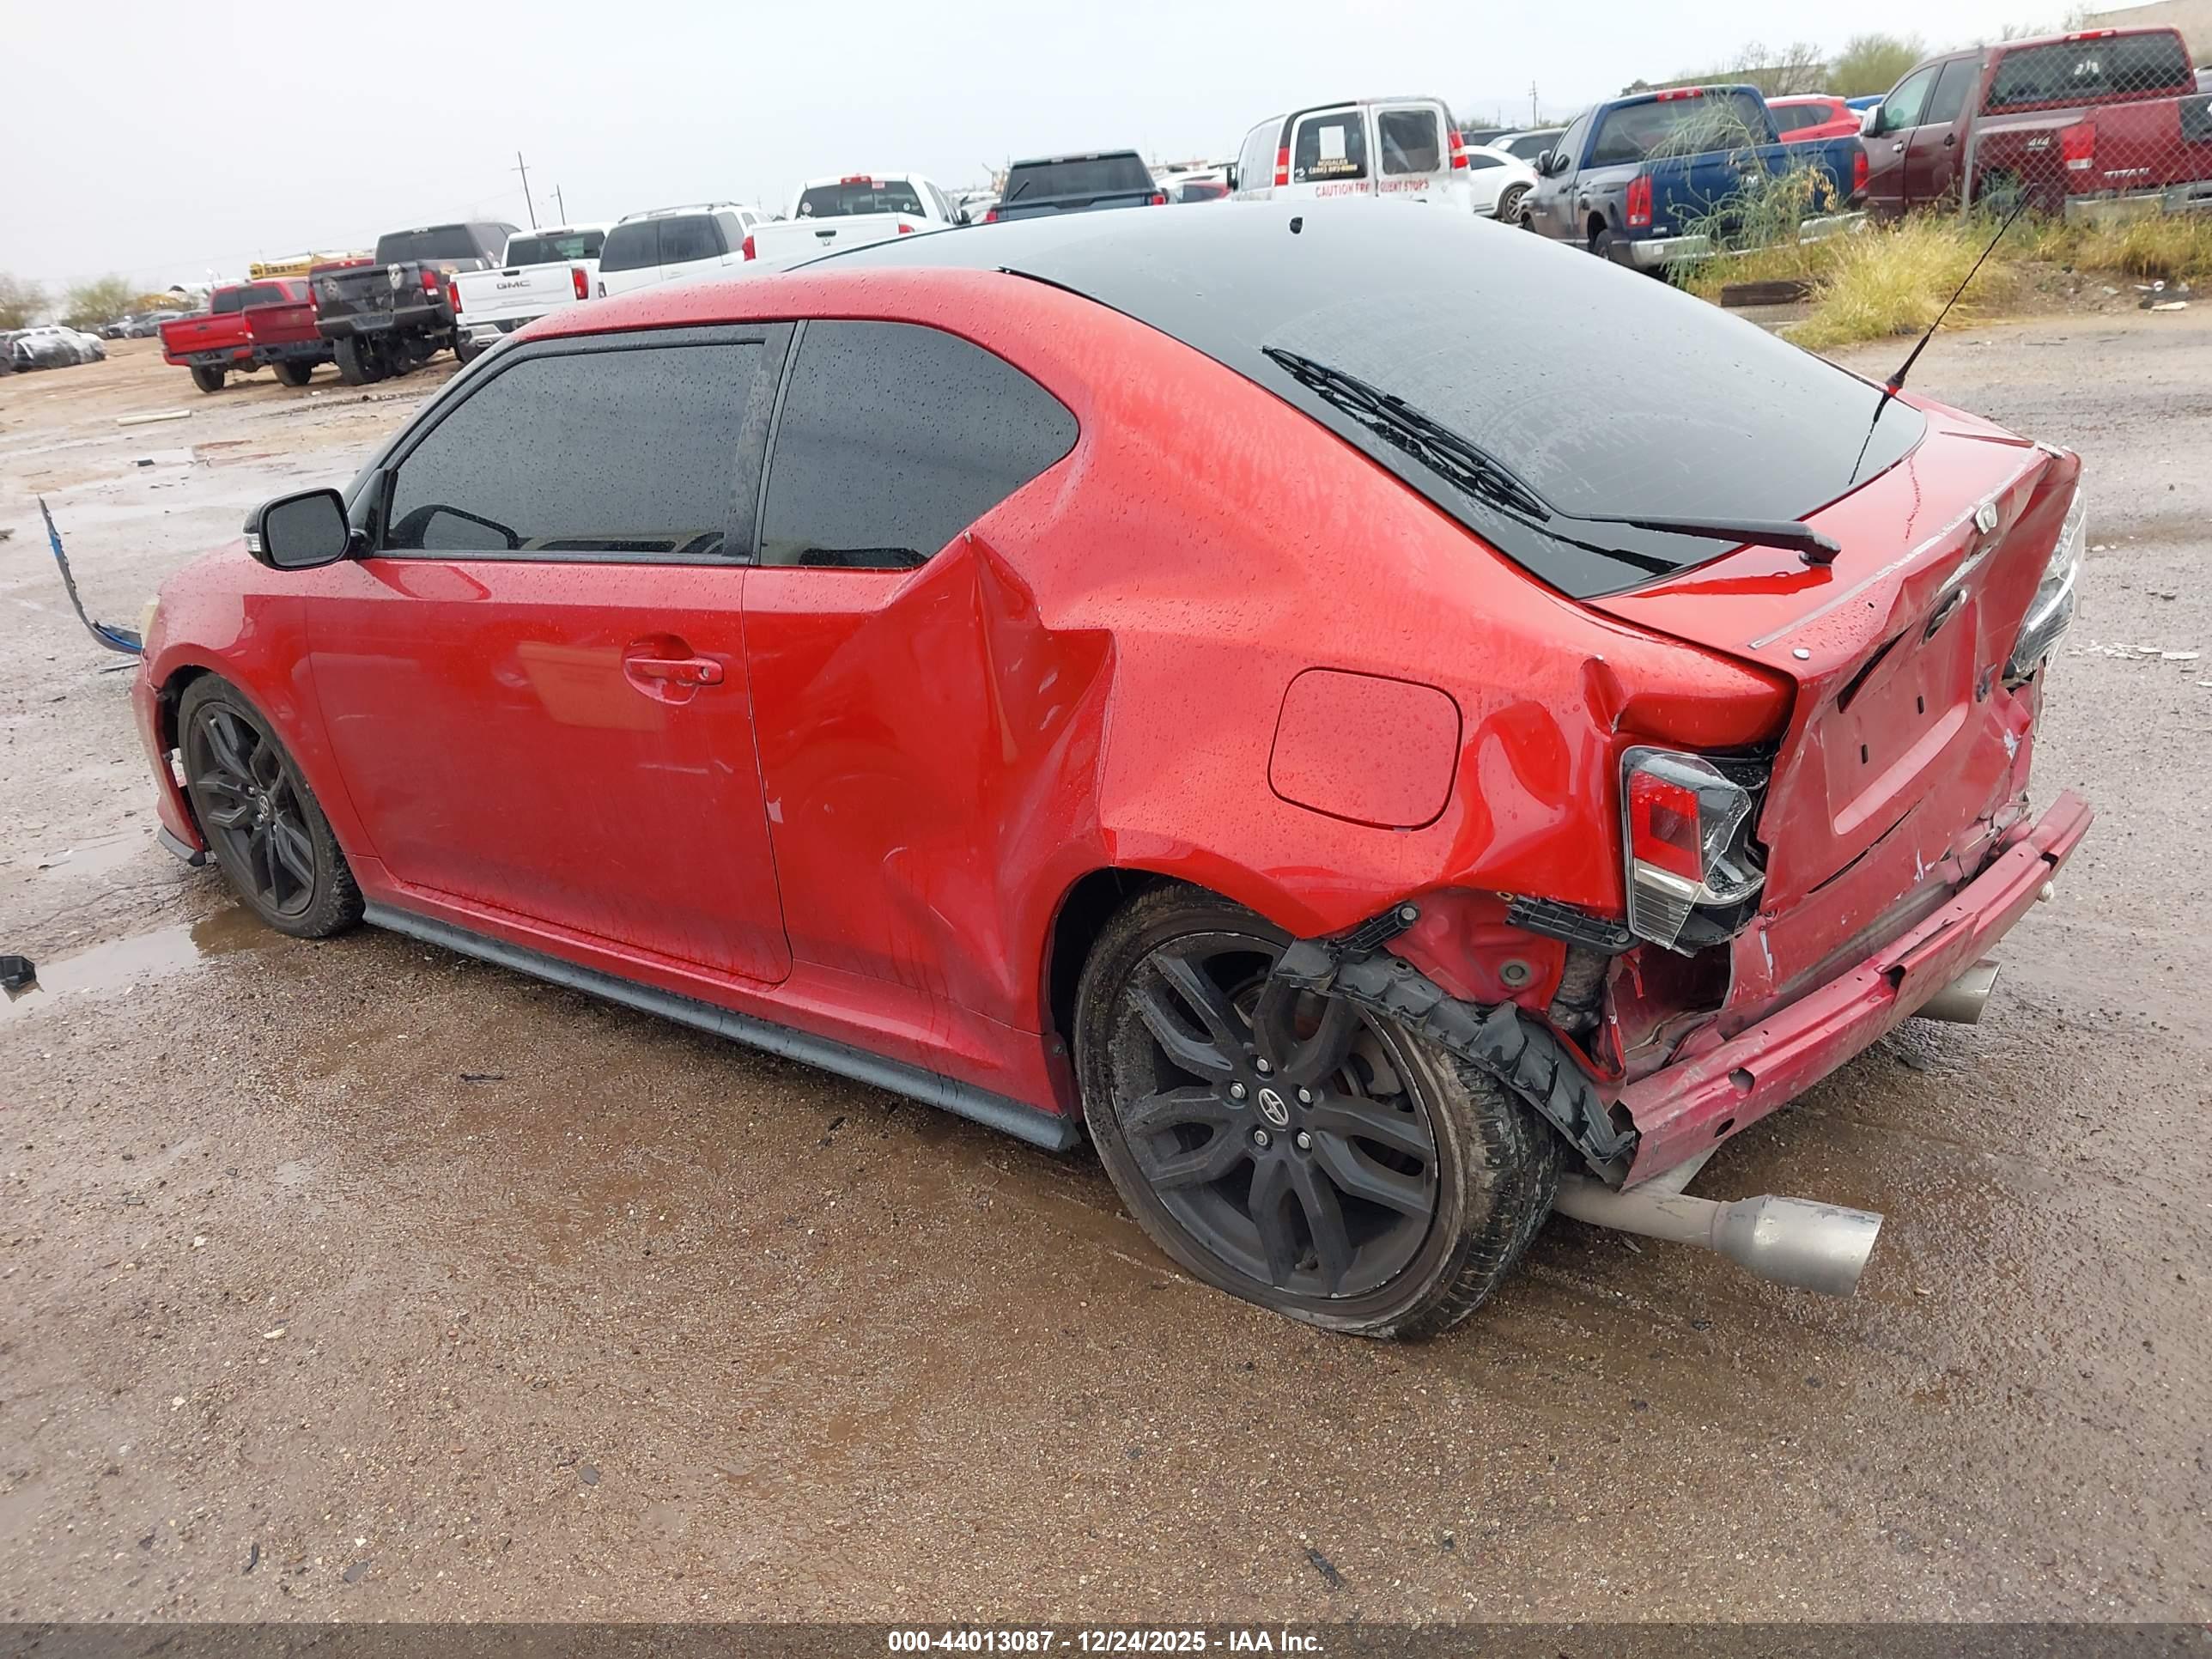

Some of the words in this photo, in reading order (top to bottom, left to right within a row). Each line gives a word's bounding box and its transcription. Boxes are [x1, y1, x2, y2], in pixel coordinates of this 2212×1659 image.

[2104, 167, 2150, 179] TITAN
[1316, 183, 1354, 198] CAUTION
[1403, 178, 1430, 191] STOPS
[496, 280, 531, 290] GMC
